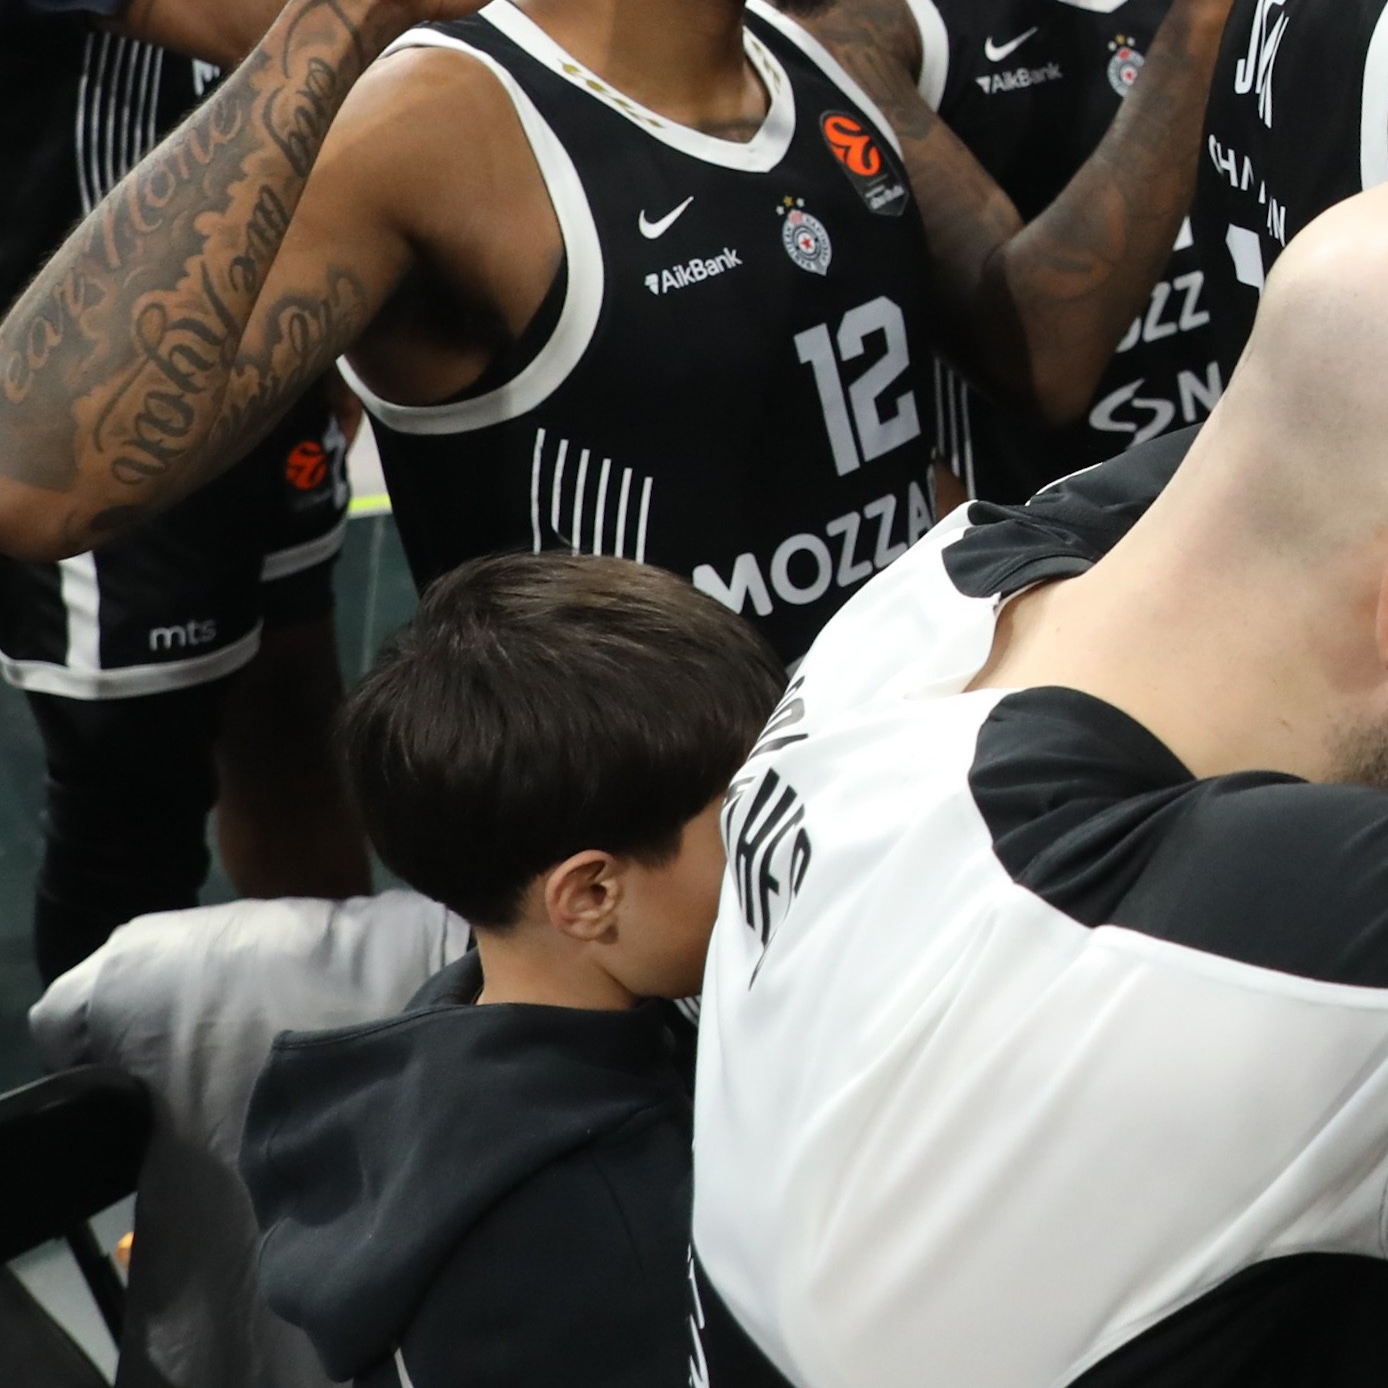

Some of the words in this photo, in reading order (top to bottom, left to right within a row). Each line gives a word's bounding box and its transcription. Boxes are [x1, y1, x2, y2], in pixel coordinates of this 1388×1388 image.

[661, 247, 743, 294] AikBank
[794, 296, 921, 477] 12
[692, 465, 937, 617] MOZZA
[150, 620, 217, 651] mts
